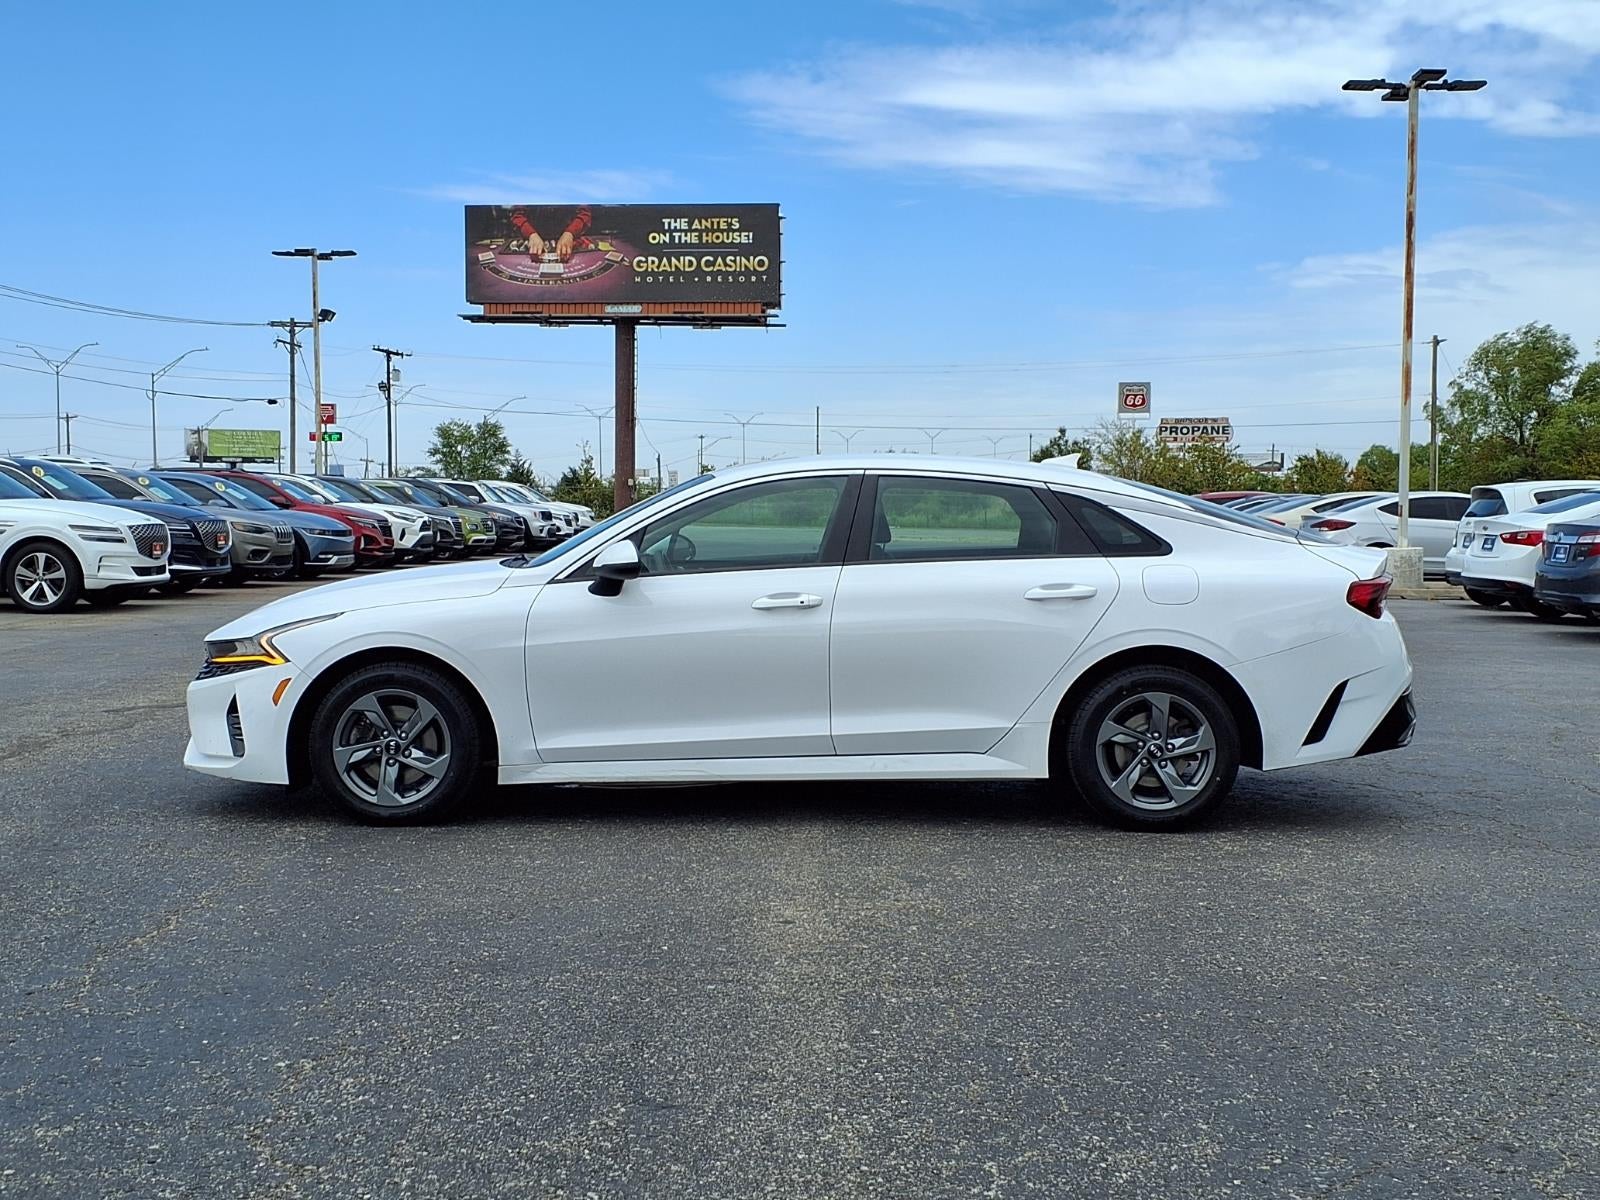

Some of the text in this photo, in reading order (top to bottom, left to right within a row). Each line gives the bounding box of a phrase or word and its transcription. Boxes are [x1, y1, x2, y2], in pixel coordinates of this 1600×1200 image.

[662, 218, 740, 230] THE ANTE'S
[648, 231, 753, 244] ON THE HOUSE!
[632, 255, 769, 272] GRAND CASINO
[706, 275, 768, 283] RESORT
[1126, 395, 1143, 406] 66
[1159, 425, 1231, 436] PROPANE
